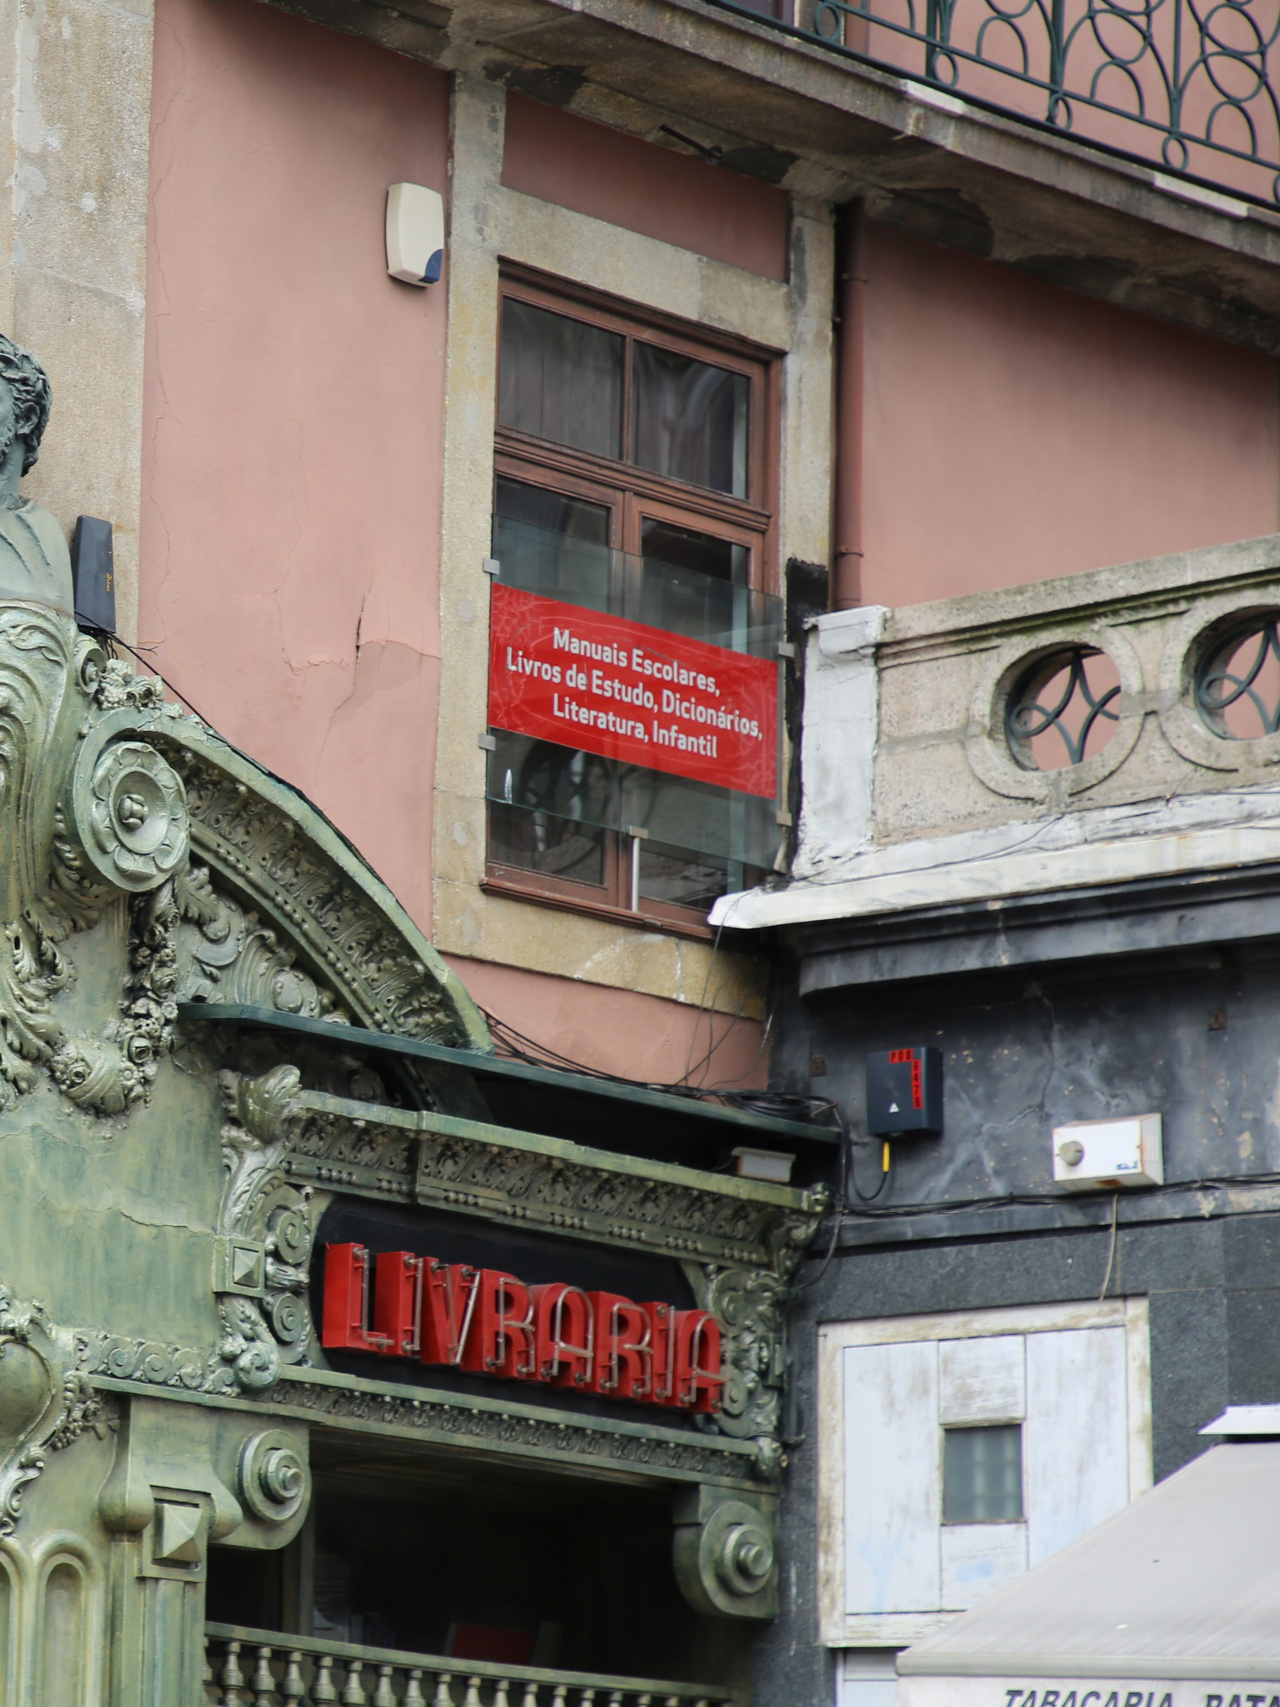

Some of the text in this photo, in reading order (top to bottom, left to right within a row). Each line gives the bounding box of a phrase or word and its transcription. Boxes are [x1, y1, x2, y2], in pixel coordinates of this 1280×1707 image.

[506, 646, 763, 741] Livros de Estudo, Dicionários,
[553, 627, 720, 697] Manuais Escolares,
[553, 693, 718, 758] Literatura, Infantil
[322, 1242, 729, 1414] LIVRARIA
